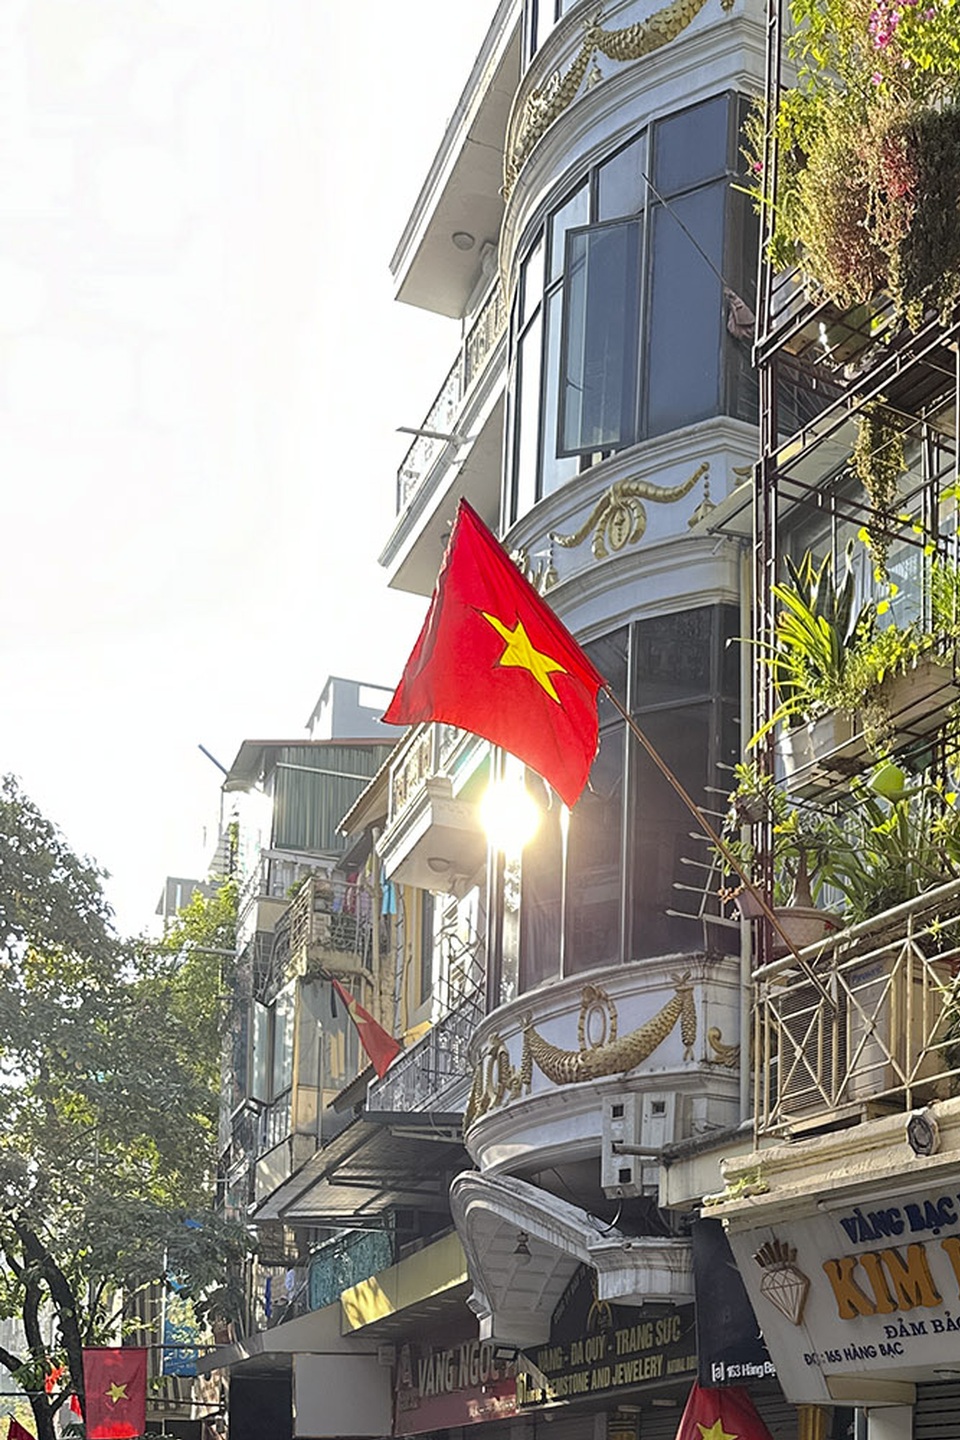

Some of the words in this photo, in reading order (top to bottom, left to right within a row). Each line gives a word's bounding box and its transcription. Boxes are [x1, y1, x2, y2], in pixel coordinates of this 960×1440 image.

[839, 1206, 906, 1245] VÀNG
[903, 1195, 959, 1236] BẠC
[822, 1241, 943, 1320] KIM
[615, 1322, 653, 1356] TRANG
[883, 1317, 928, 1339] ĐẢM
[842, 1341, 878, 1361] HÀNG
[877, 1341, 905, 1360] BẠC
[590, 1366, 611, 1390] AND
